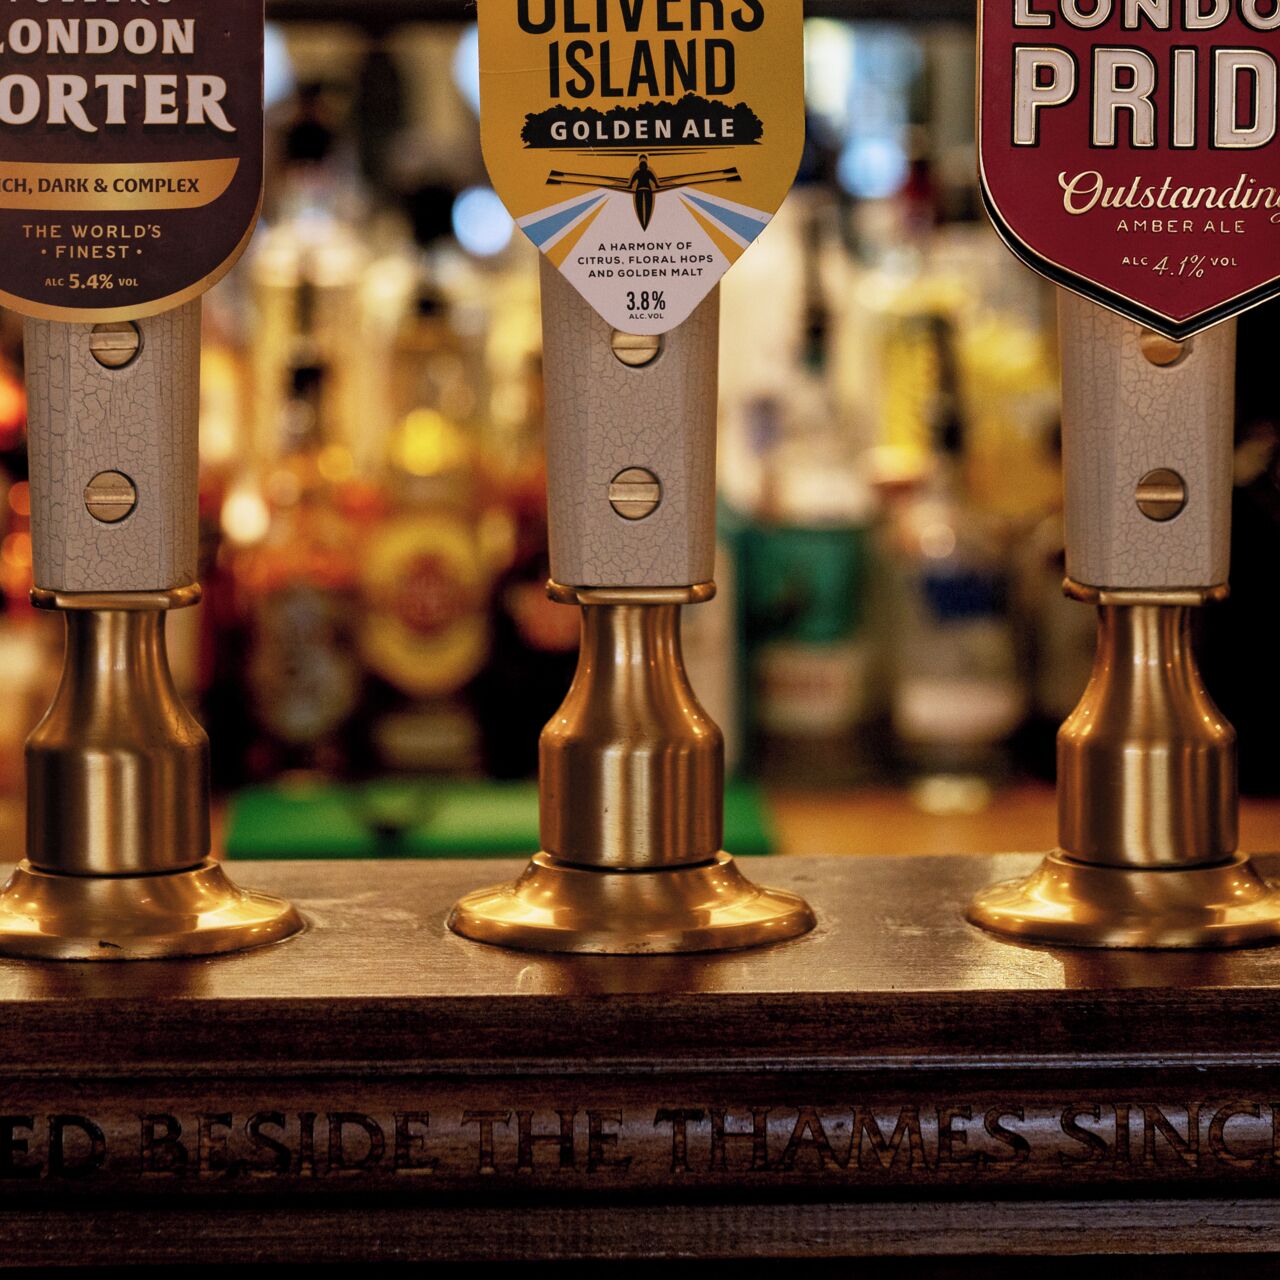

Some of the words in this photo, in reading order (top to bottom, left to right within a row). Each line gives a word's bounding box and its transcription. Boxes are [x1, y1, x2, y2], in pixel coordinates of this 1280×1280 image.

[549, 38, 736, 99] ISLAND
[550, 120, 672, 141] GOLDEN
[682, 119, 735, 139] ALE
[38, 178, 89, 193] DARK
[94, 178, 108, 193] &
[113, 178, 200, 193] COMPLEX
[22, 224, 62, 238] THE
[72, 223, 161, 238] WORLD'S
[1116, 219, 1193, 233] AMBER
[1204, 220, 1245, 233] ALE
[598, 243, 606, 252] A
[610, 242, 672, 251] HARMONY
[676, 241, 693, 250] OF
[628, 255, 677, 264] FLORAL
[680, 254, 714, 263] HOPS
[1121, 256, 1148, 266] ALC
[1151, 254, 1206, 278] 4.1%
[1210, 257, 1238, 266] VOL
[588, 269, 614, 278] AND
[617, 268, 667, 278] GOLDEN
[671, 268, 703, 277] MALT
[45, 278, 65, 287] ALC
[69, 273, 114, 289] 5.4%
[118, 278, 138, 287] VOL
[626, 290, 666, 311] 3.8%
[140, 1111, 438, 1177] BESIDE
[461, 1110, 634, 1175] THE
[654, 1105, 1030, 1173] THAMES
